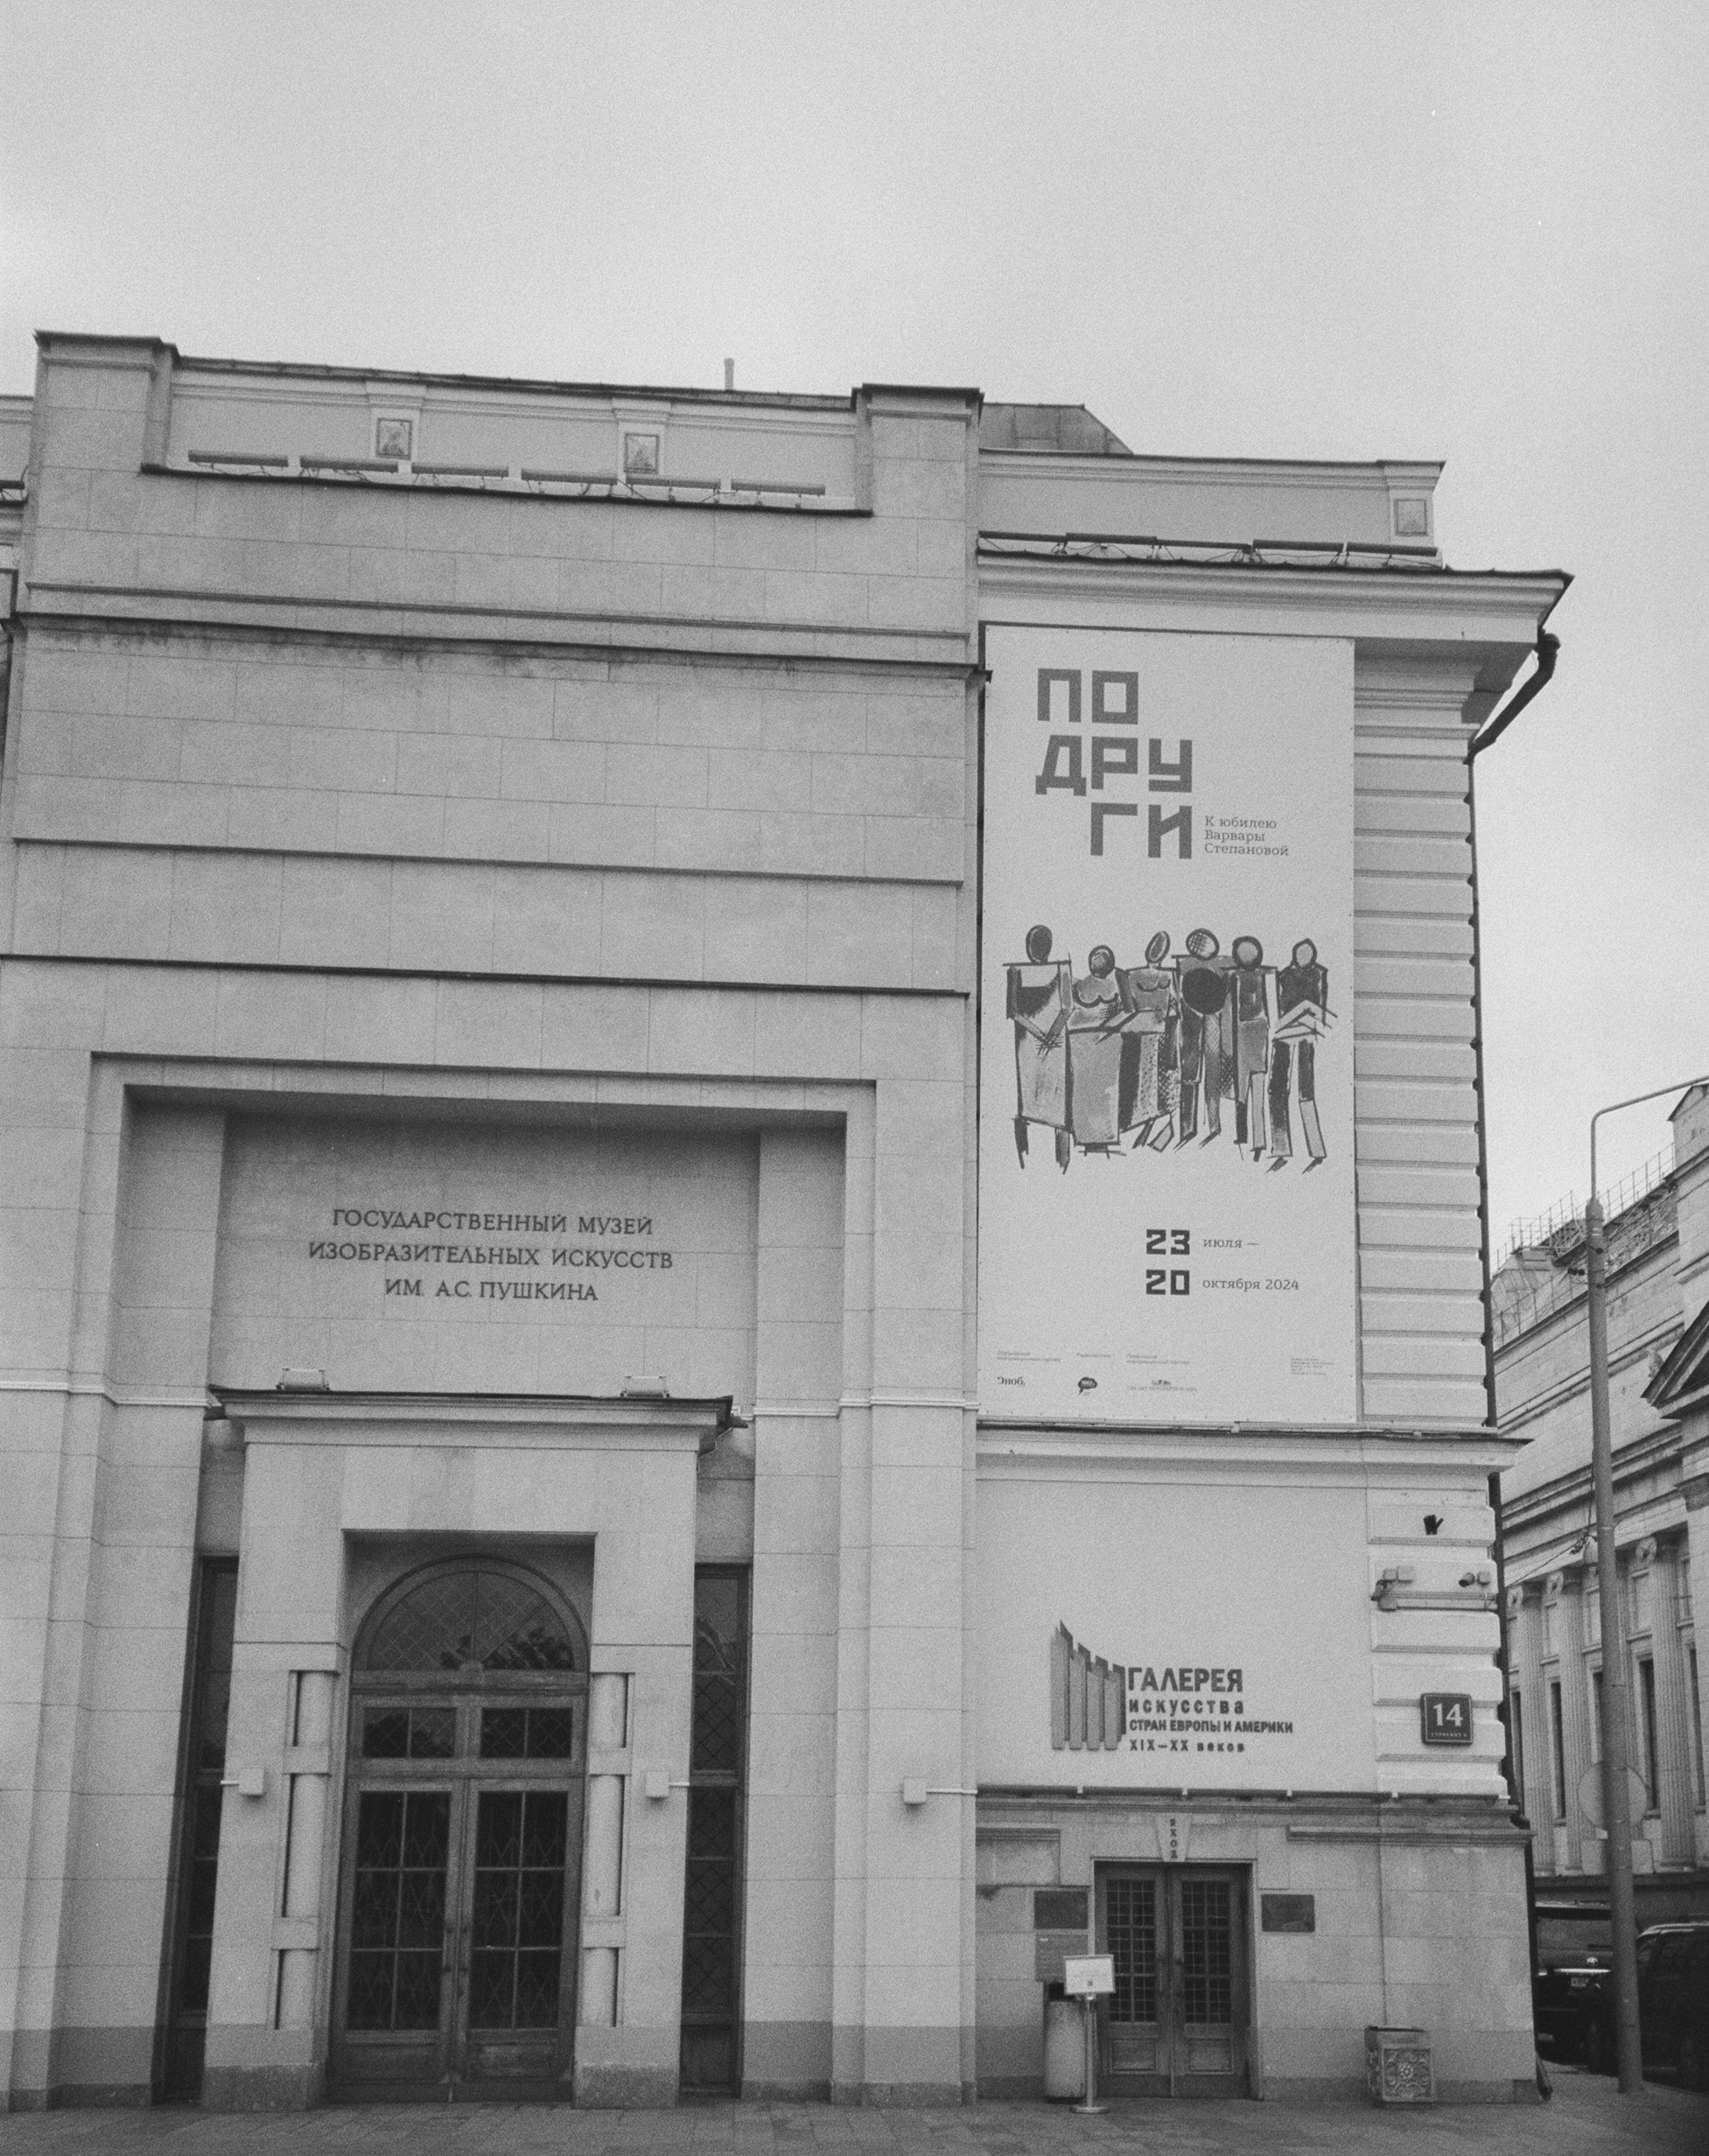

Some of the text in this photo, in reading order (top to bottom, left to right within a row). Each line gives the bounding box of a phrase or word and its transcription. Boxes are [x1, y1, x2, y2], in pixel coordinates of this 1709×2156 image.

[1037, 668, 1138, 724] ПО
[1035, 734, 1193, 796] ДРУ
[1089, 802, 1192, 859] ГИ
[1205, 816, 1278, 829] К юбилею
[1205, 829, 1265, 842] Варвары
[1204, 841, 1290, 857] Степановой
[332, 1208, 653, 1236] ГОСУДАРСТВЕННЫЙ МУЗЕЙ
[1145, 1228, 1190, 1256] 23
[1202, 1238, 1243, 1250] июля
[308, 1241, 673, 1270] ИЗОБРАЗИТЕЛЬНЫХ ИСКУССТВ
[385, 1278, 599, 1301] ИМ. А.С. ПУШКИНА
[1145, 1269, 1190, 1296] 20
[1202, 1278, 1299, 1292] октября 2024
[1128, 1667, 1243, 1692] ГАЛЕРЕЯ
[1129, 1699, 1243, 1717] искусства
[1432, 1703, 1463, 1726] 14
[1130, 1719, 1293, 1733] СТРАН ЕВРОПЫ И АМЕРИКИ
[1197, 1742, 1245, 1753] веков
